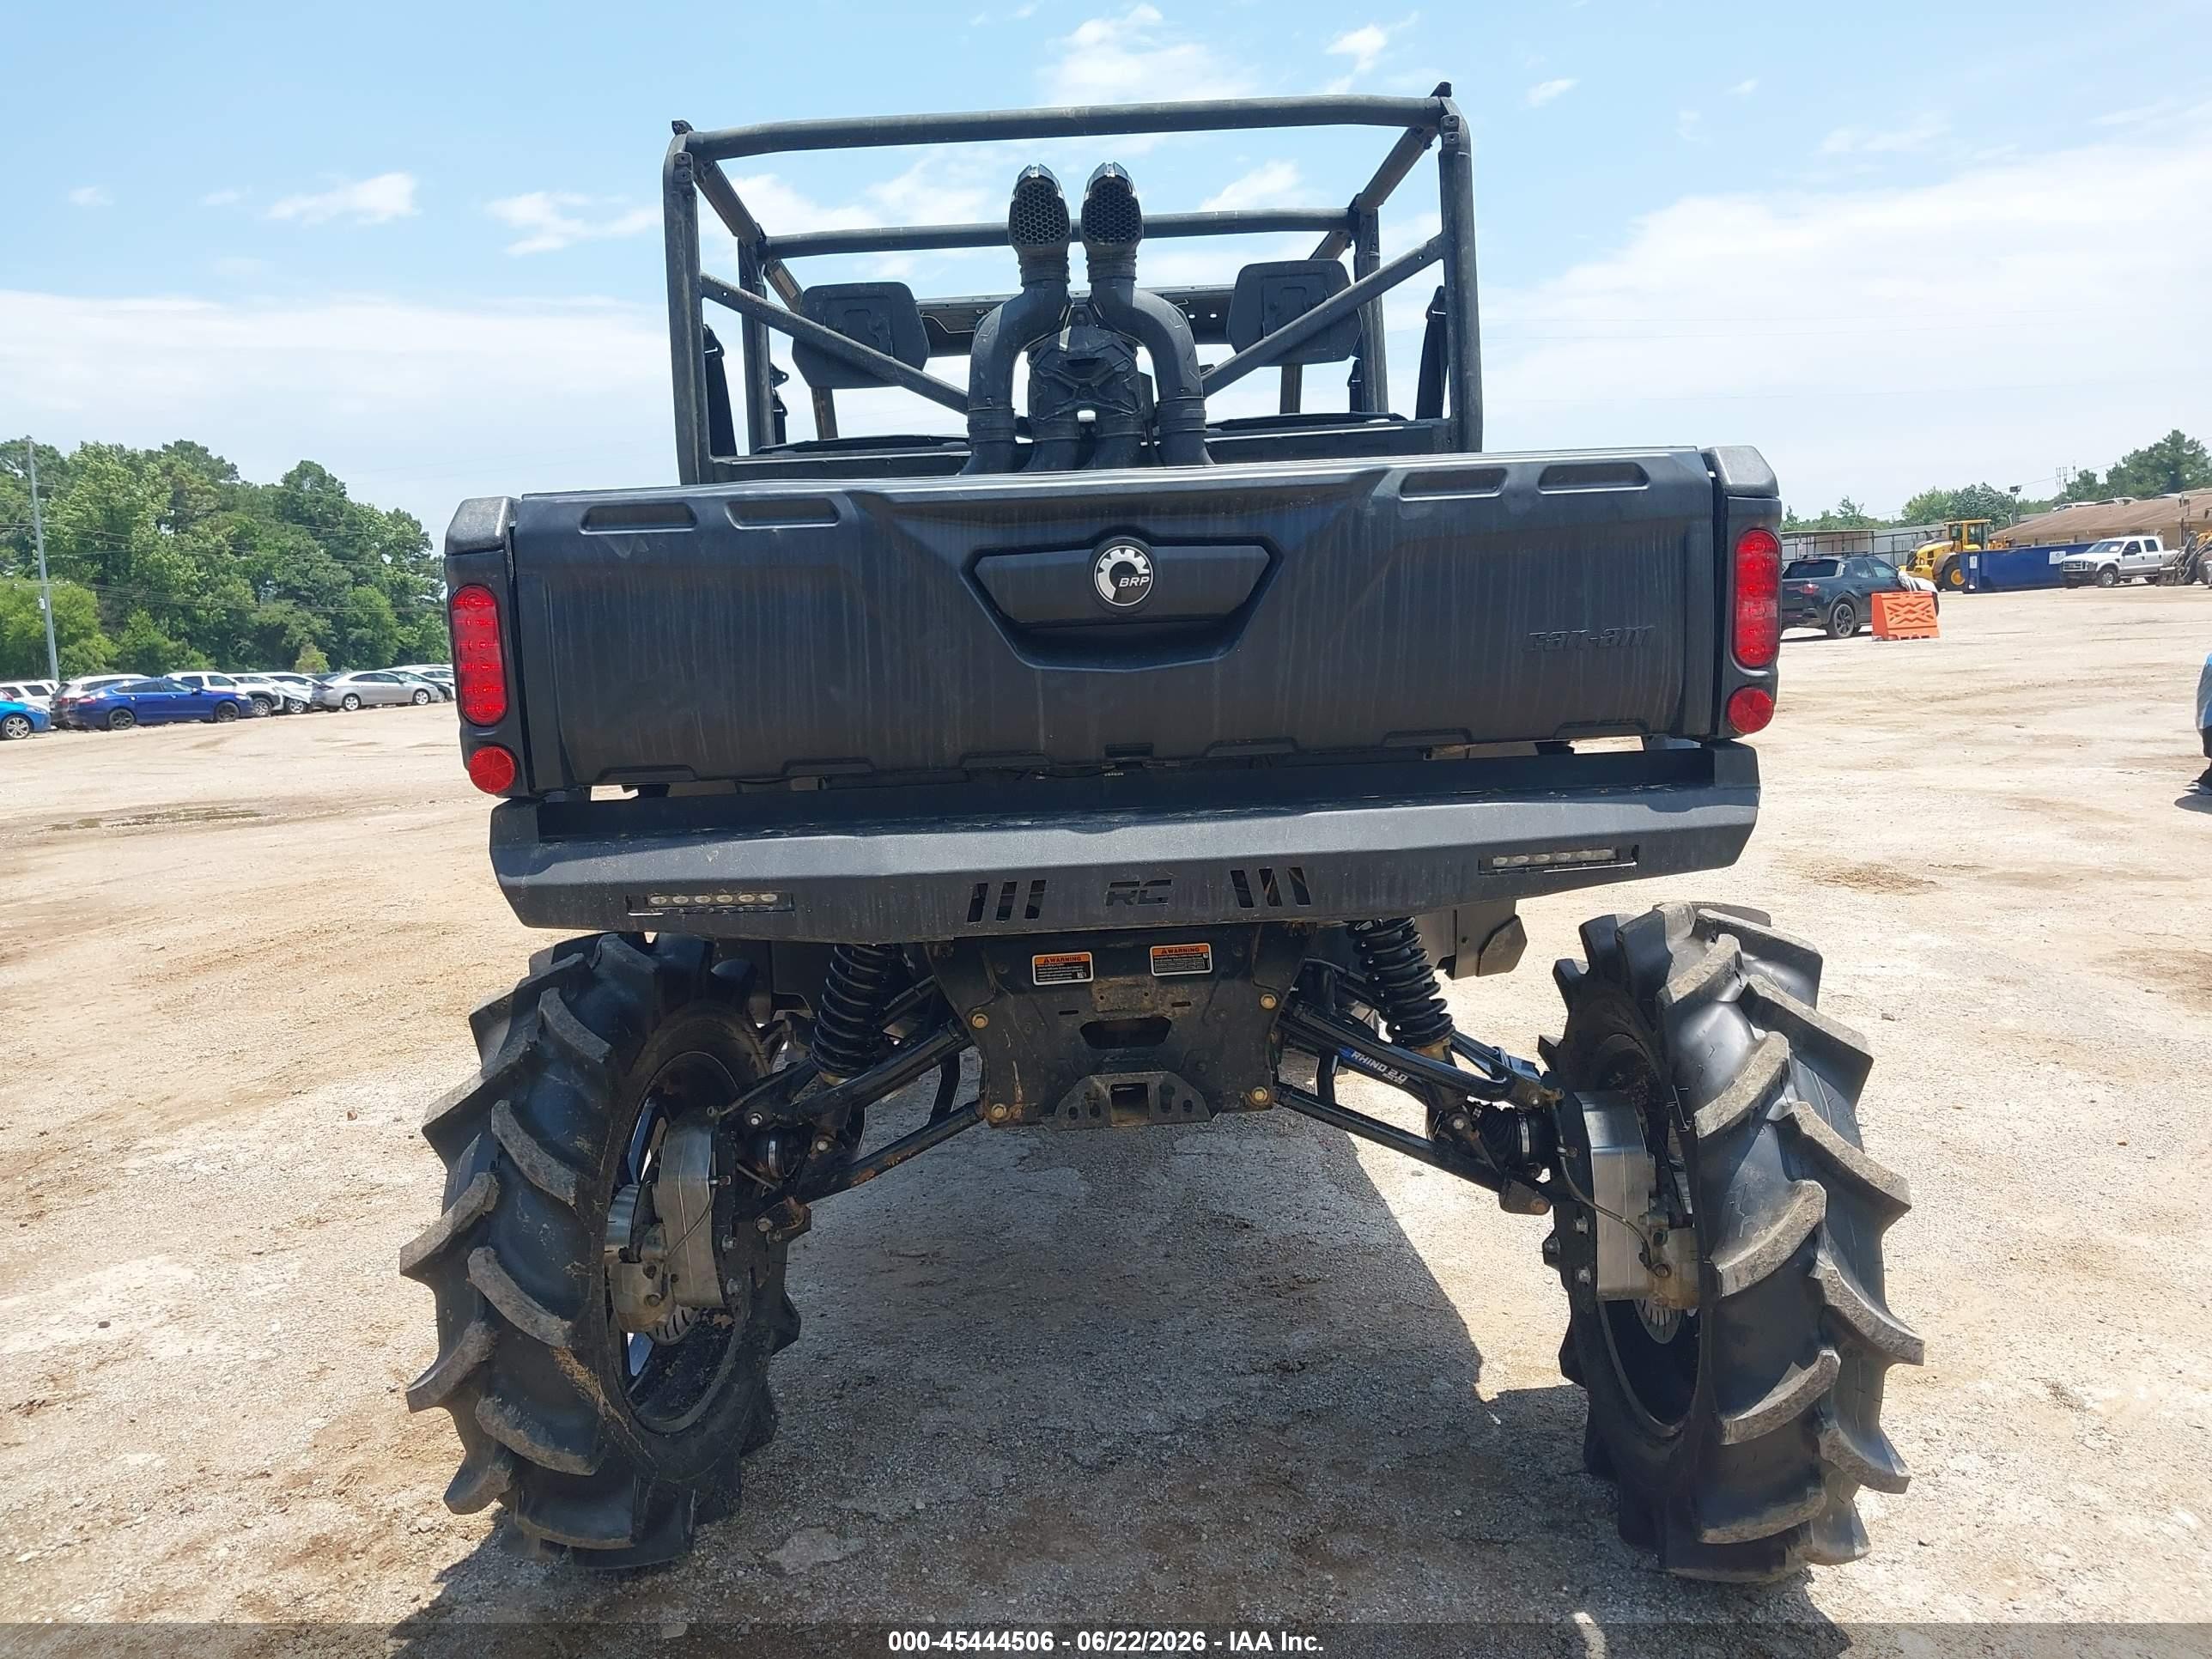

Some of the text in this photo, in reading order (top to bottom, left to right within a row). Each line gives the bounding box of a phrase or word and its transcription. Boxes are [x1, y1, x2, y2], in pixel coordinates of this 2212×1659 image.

[1119, 576, 1150, 587] BRP
[1105, 879, 1172, 906] RC
[1351, 1050, 1388, 1073] RHINO
[1388, 1067, 1409, 1083] 2.0
